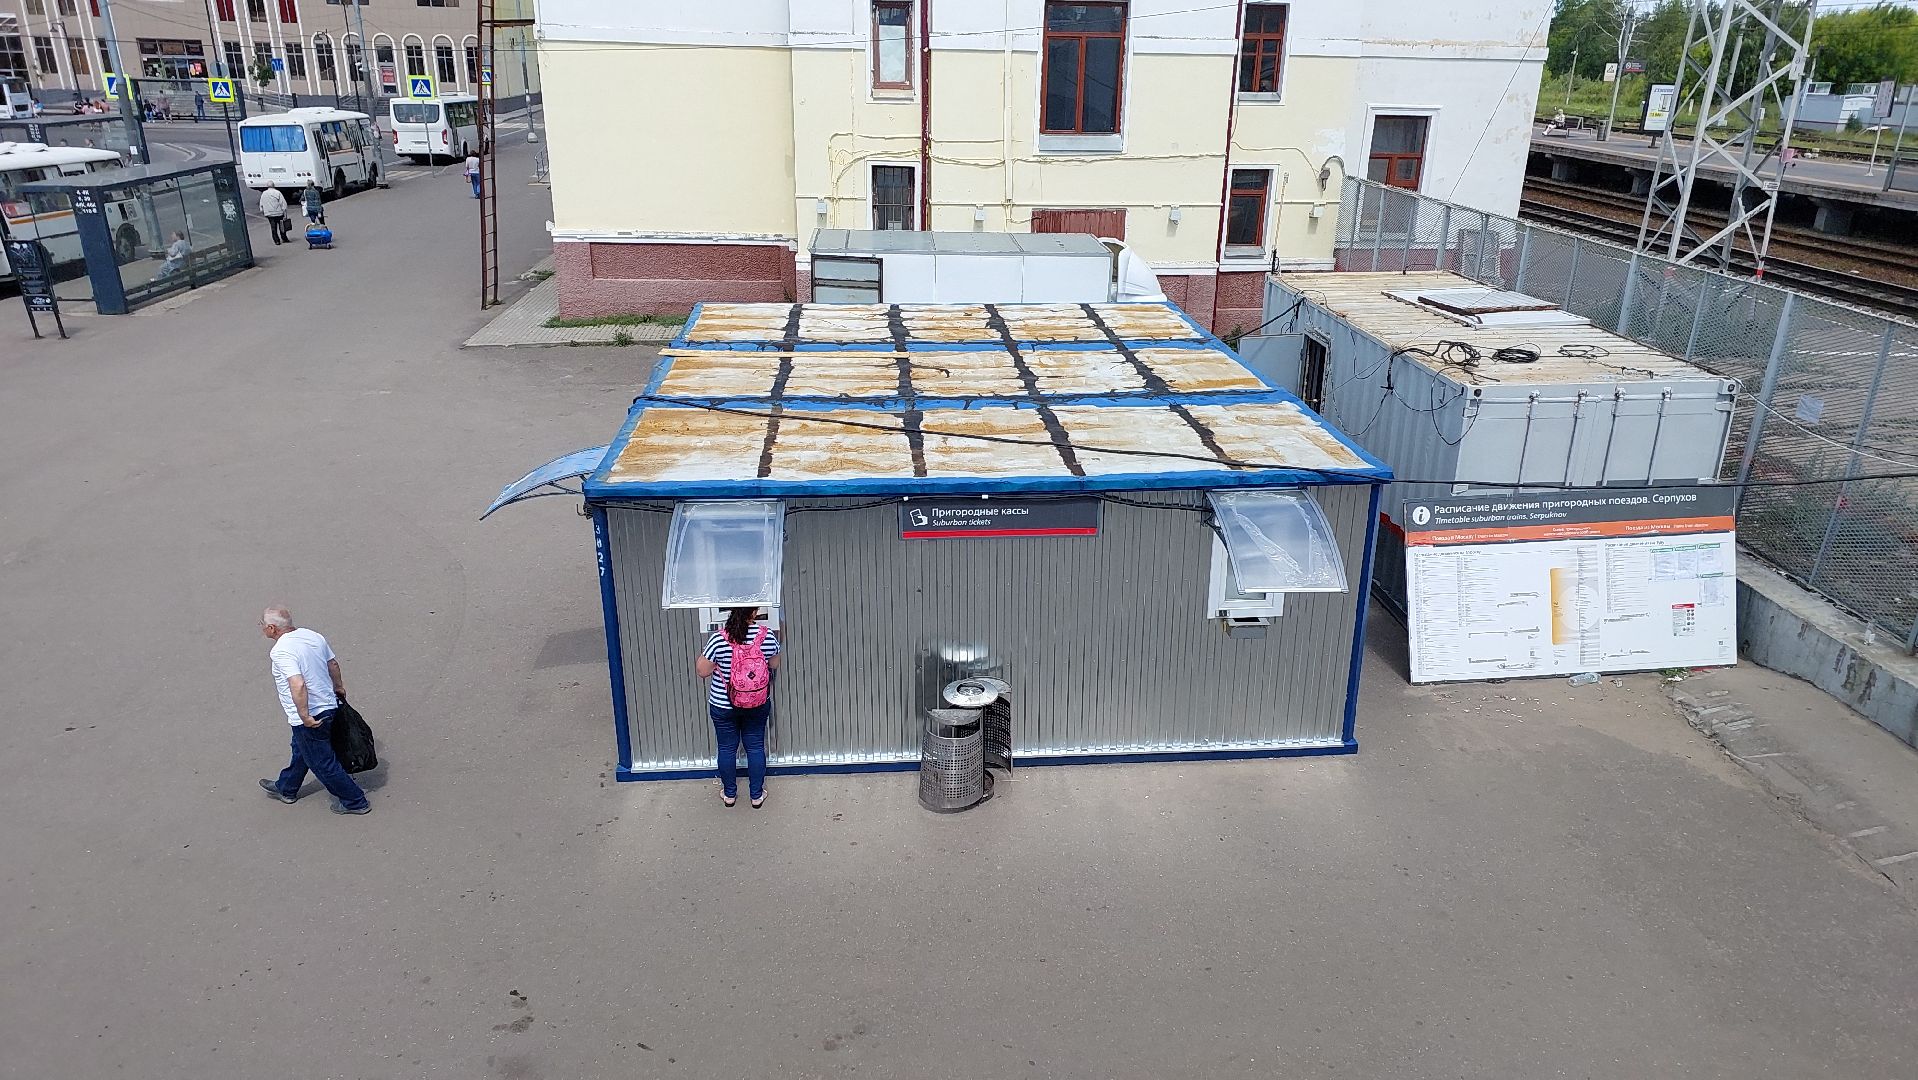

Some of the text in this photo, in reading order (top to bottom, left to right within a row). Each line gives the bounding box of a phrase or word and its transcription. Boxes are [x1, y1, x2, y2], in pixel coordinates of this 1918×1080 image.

[1434, 493, 1697, 514] Расписание движения пригородных поездов. Серпухов
[931, 507, 1029, 518] Пригородные кассы
[1434, 515, 1470, 525] Timetable
[1471, 514, 1505, 523] suburban
[1529, 511, 1568, 520] Serpukhov
[932, 518, 992, 527] Suburban tickets
